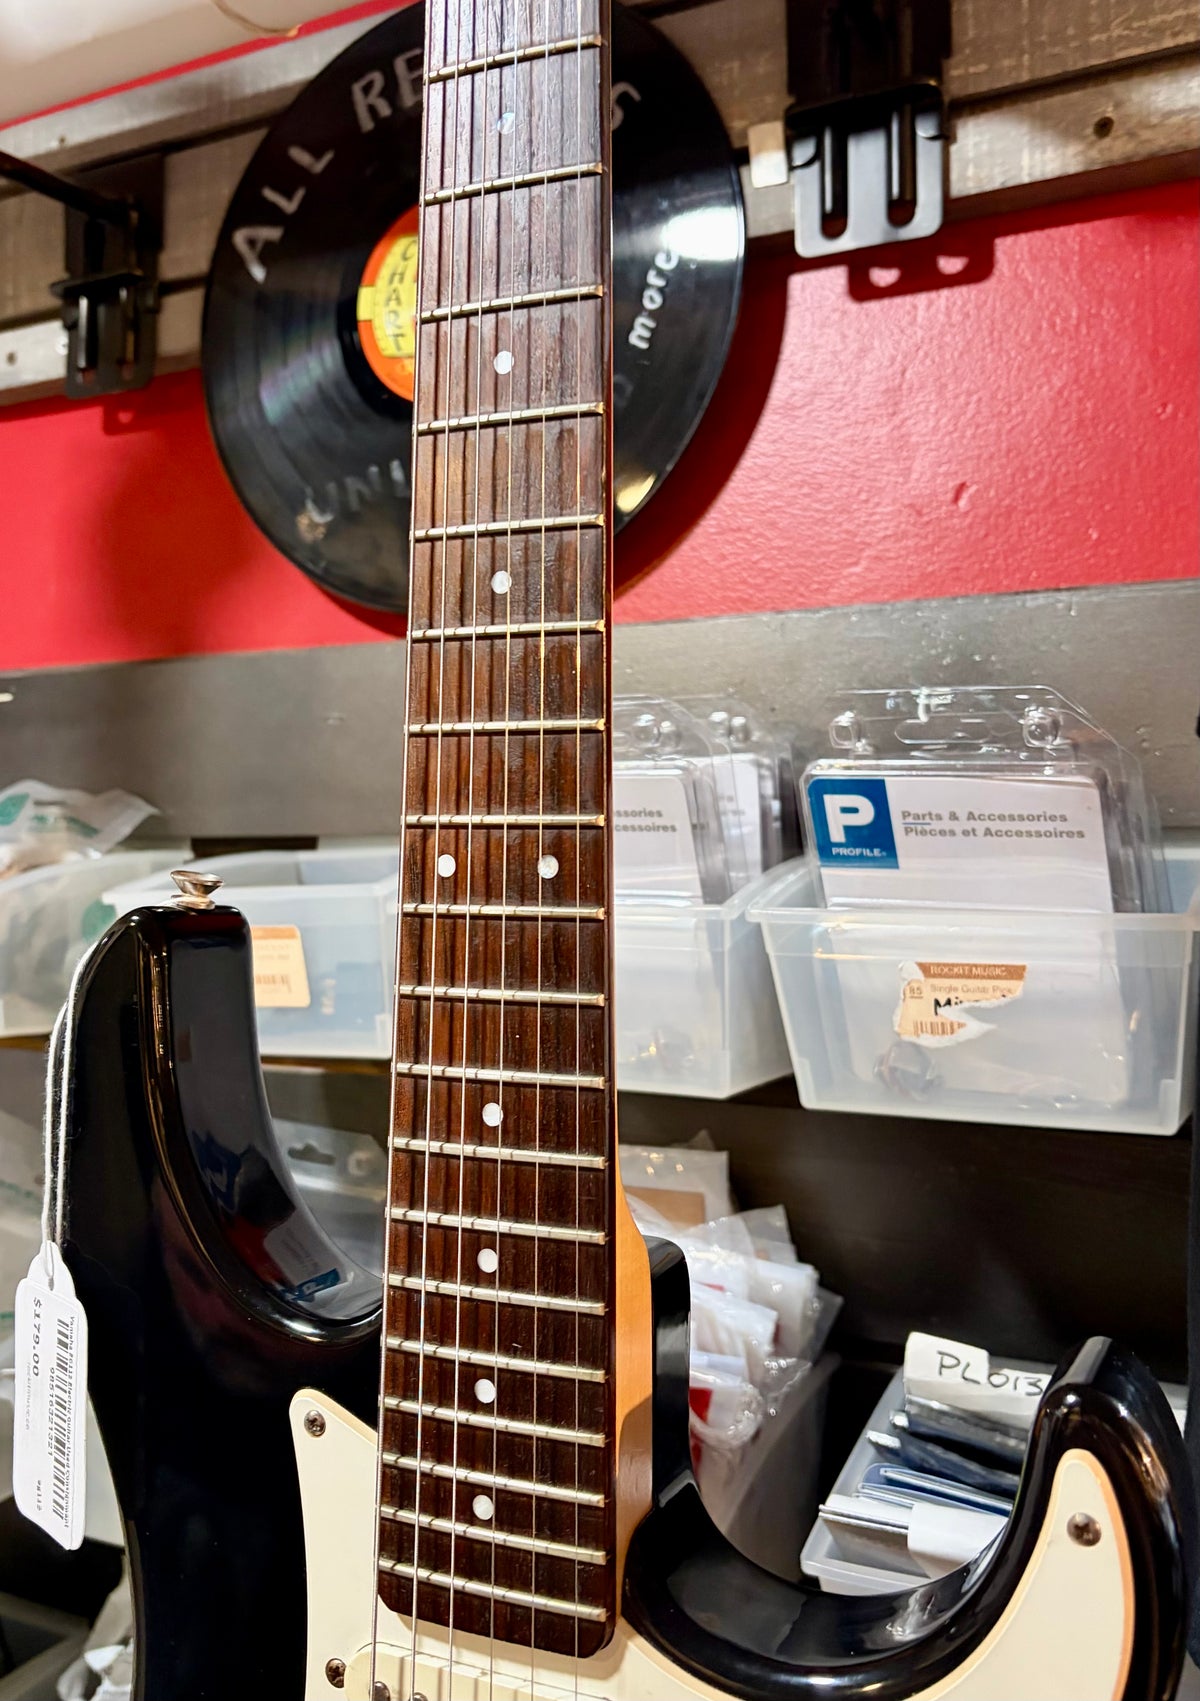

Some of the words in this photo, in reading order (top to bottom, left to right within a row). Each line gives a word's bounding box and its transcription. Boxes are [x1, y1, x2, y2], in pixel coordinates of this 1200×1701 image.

[231, 144, 335, 284] ALL
[384, 240, 417, 353] CHART
[613, 808, 663, 818] ssories
[823, 794, 875, 843] P
[901, 810, 943, 822] Parts
[948, 811, 960, 822] &
[966, 811, 1068, 823] Accessories
[613, 821, 677, 833] cessoires
[904, 826, 957, 838] Pièces
[961, 828, 978, 838] et
[983, 827, 1086, 839] Accessoires
[930, 966, 969, 975] ROCKIT
[972, 967, 1007, 976] MUSIC
[930, 984, 959, 994] Single
[961, 985, 989, 994] Guitar
[32, 1297, 42, 1377] $179.00
[937, 1350, 1043, 1396] PL013
